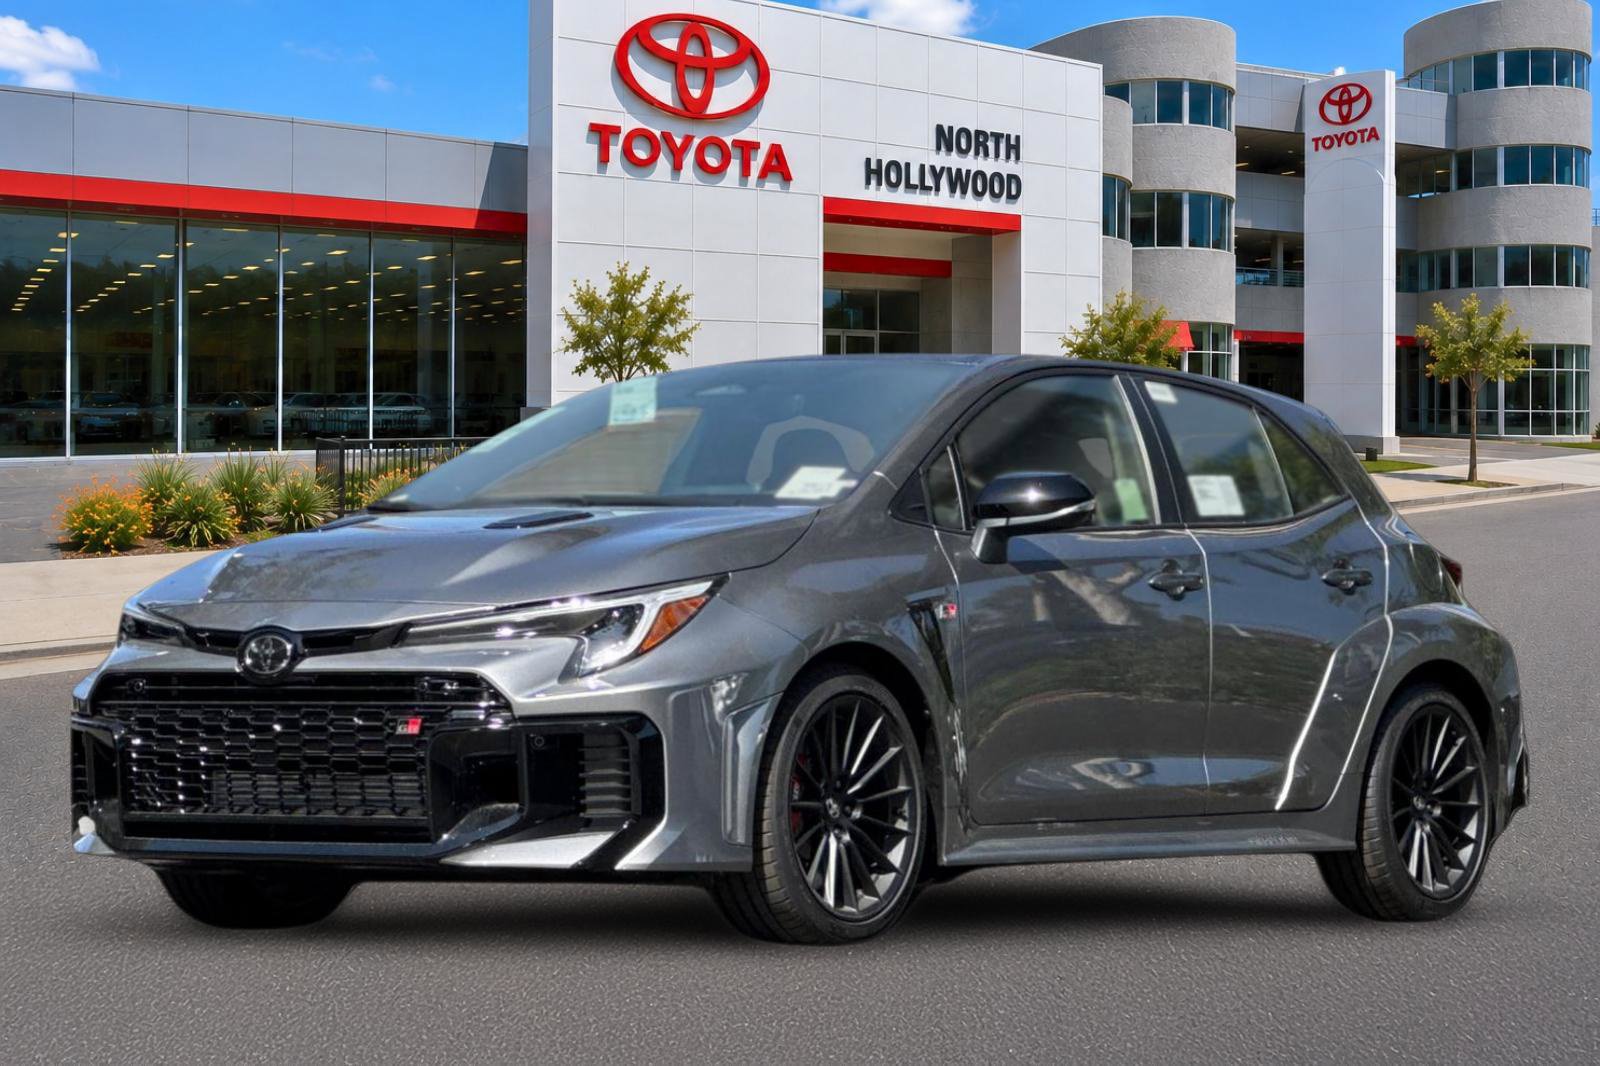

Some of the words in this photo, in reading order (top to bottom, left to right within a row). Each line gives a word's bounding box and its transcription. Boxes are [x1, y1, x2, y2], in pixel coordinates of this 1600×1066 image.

[589, 122, 793, 181] TOYOTA
[935, 123, 1021, 161] NORTH
[1312, 126, 1380, 152] TOYOTA
[865, 157, 1022, 200] HOLLYWOOD
